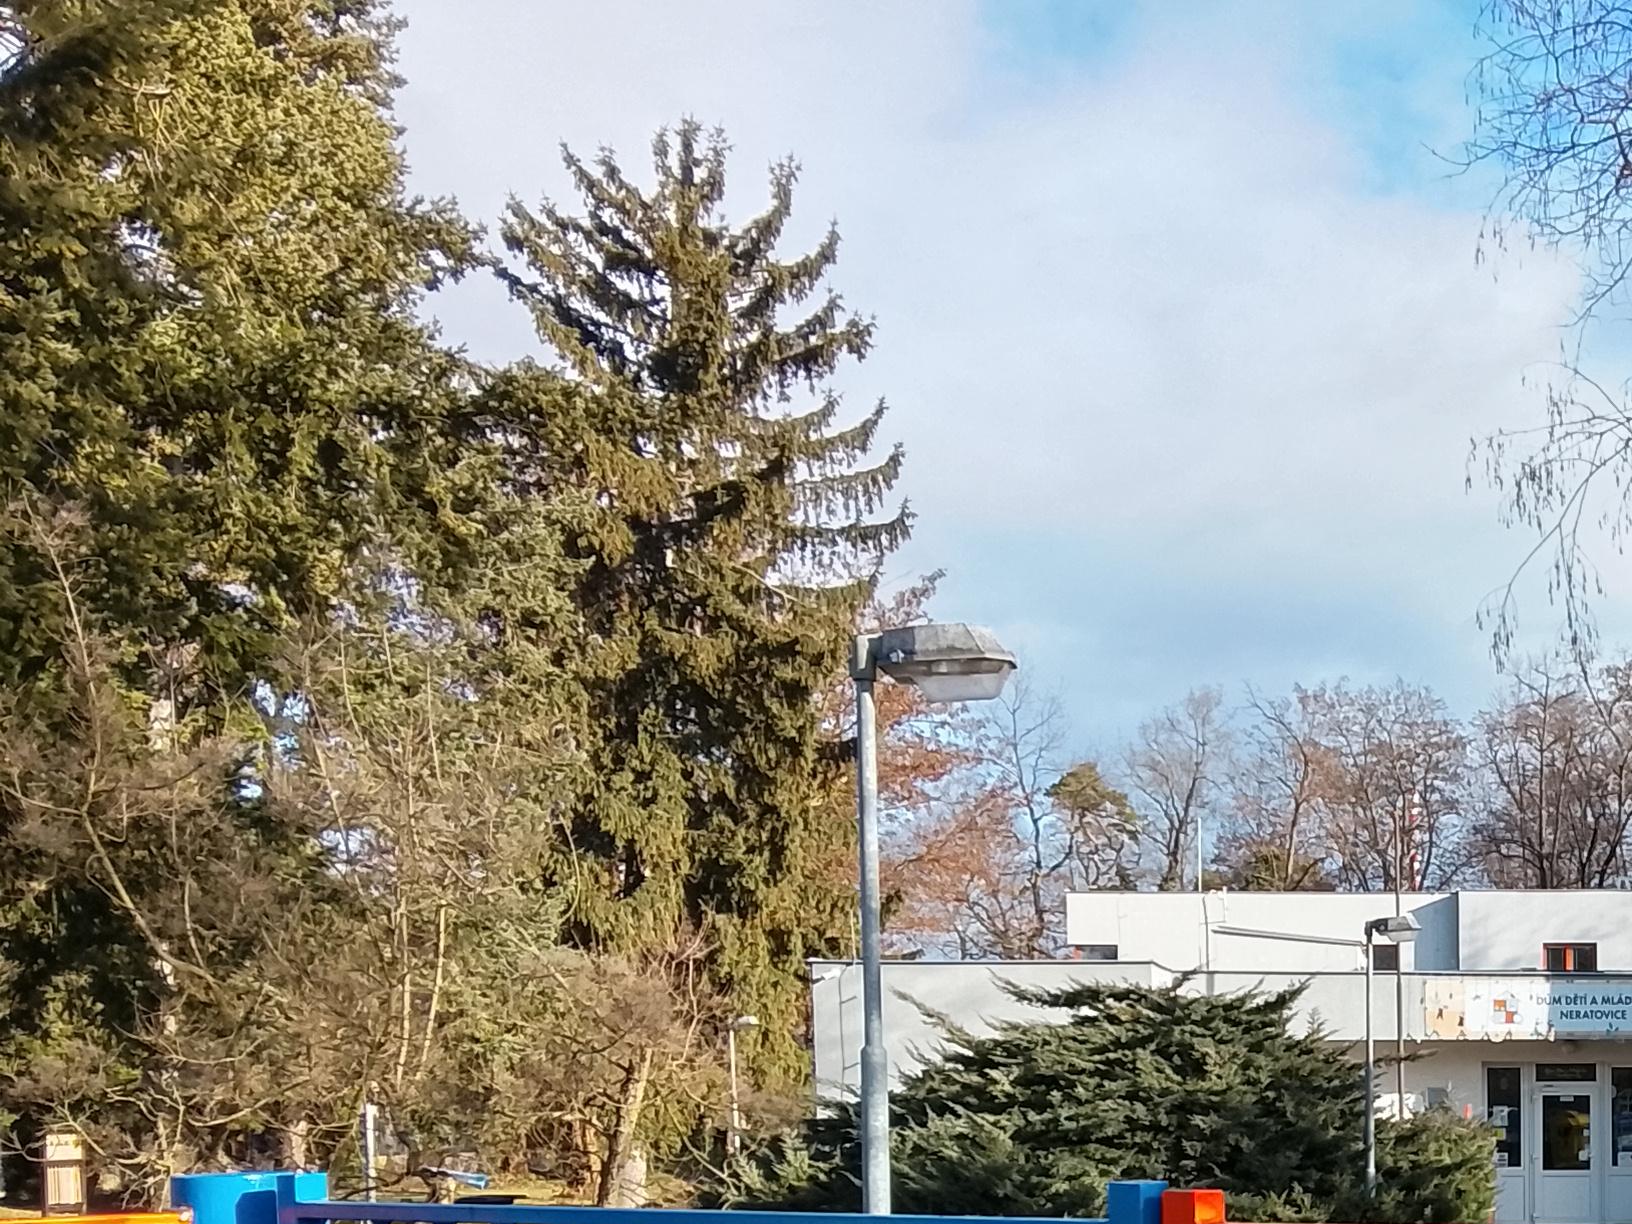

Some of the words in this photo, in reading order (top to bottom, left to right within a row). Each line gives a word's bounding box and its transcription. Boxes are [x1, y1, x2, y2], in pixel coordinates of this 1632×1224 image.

[1565, 993, 1587, 1006] DĚTÍ
[1590, 995, 1599, 1006] A
[1560, 1009, 1627, 1020] NERATOVICE
